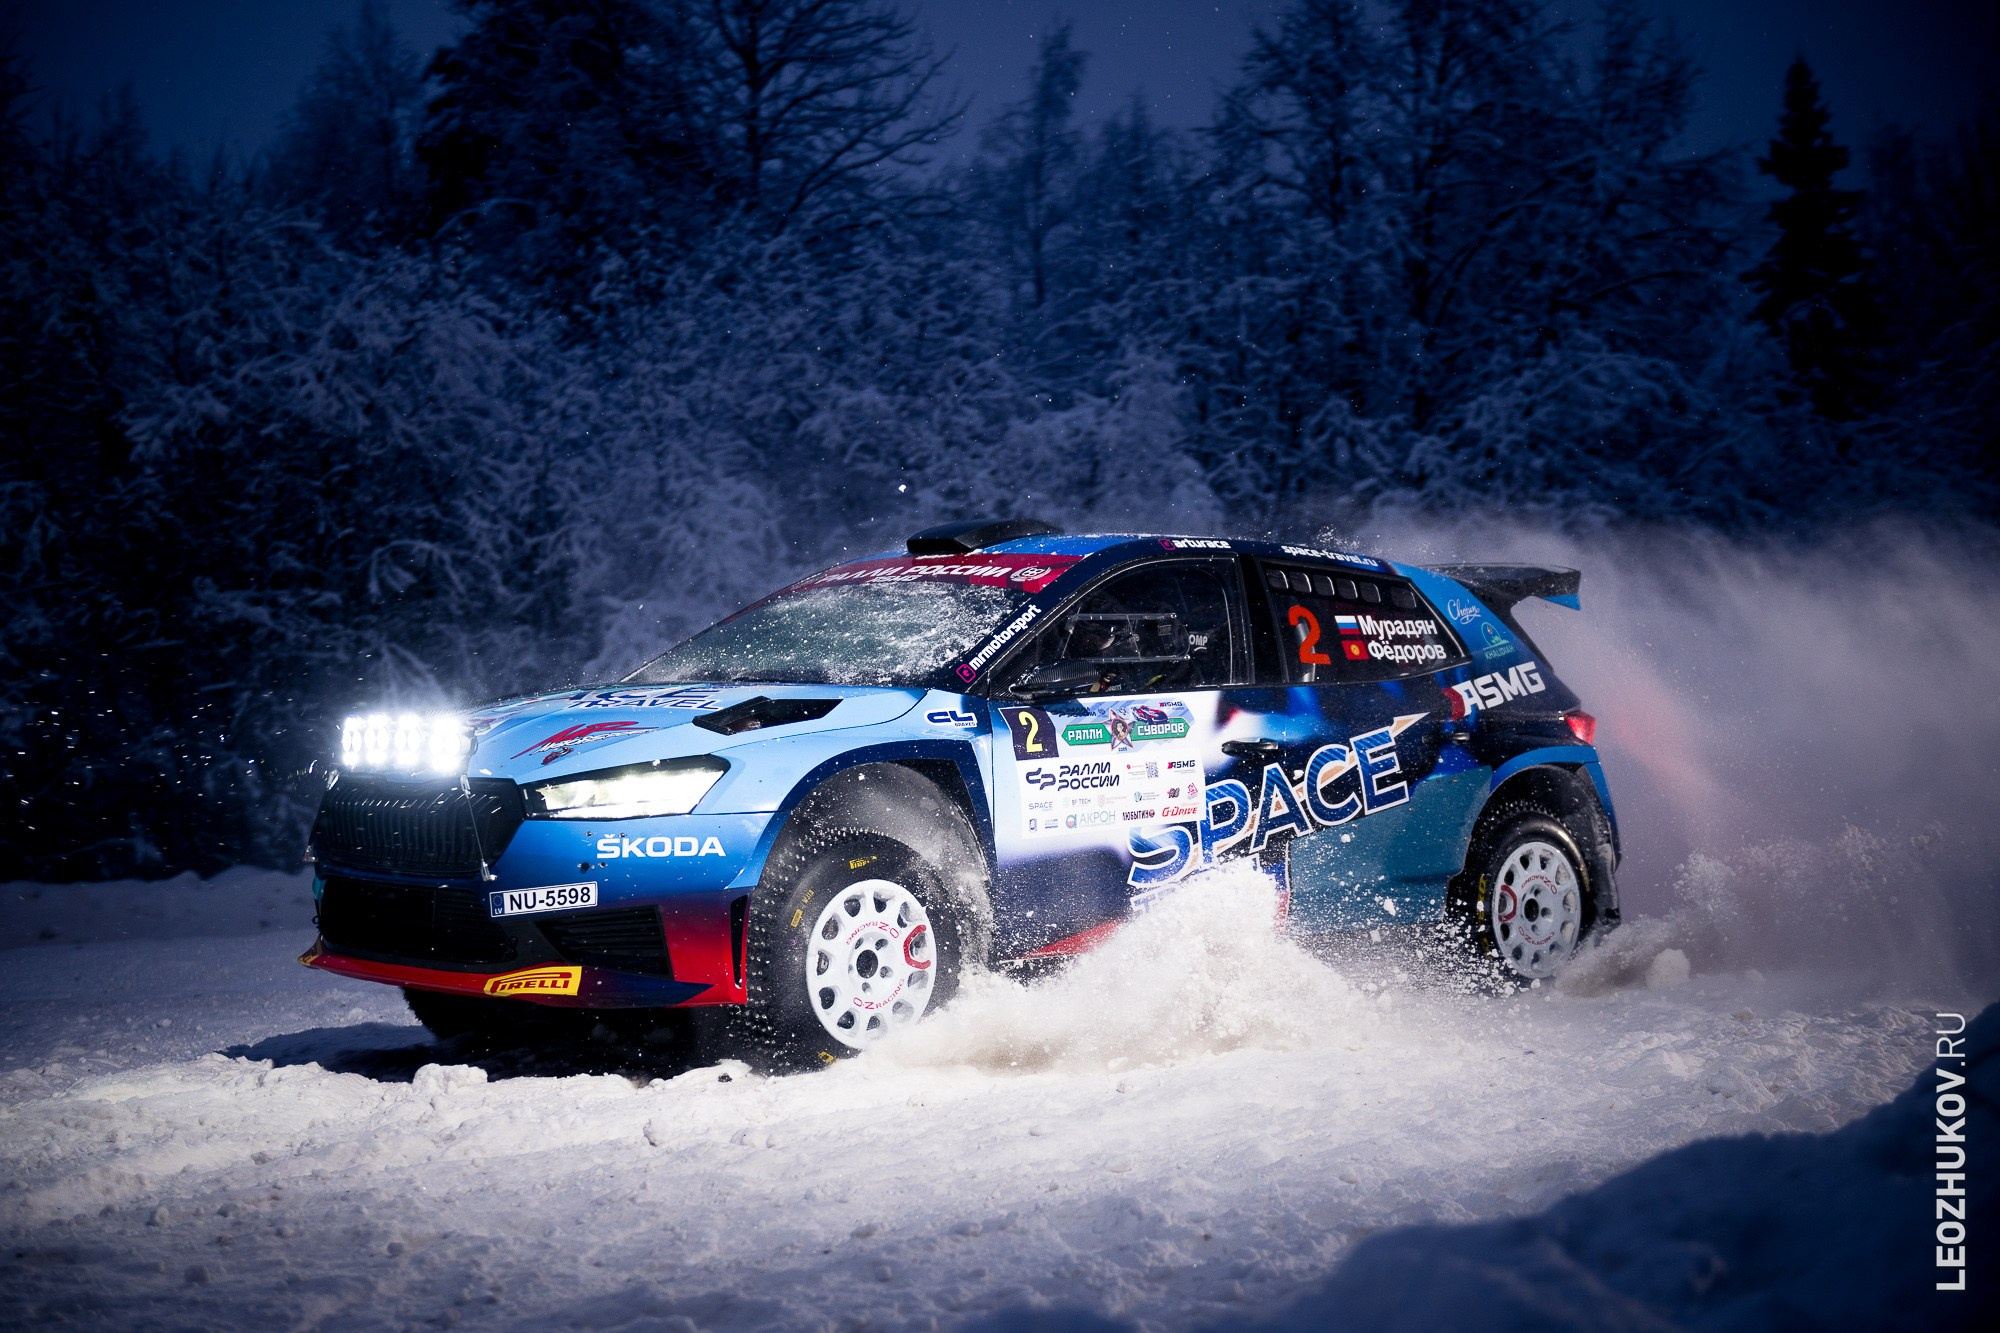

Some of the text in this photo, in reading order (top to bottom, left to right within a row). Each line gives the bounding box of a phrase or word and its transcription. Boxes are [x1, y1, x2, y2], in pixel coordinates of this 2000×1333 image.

[1173, 538, 1232, 549] arturace
[1281, 545, 1380, 567] space-travel.ru
[902, 565, 1012, 577] РОССИИ
[968, 604, 1042, 671] mrmotorsport
[1288, 605, 1331, 666] 2
[1357, 615, 1438, 640] Мурадян
[1188, 634, 1208, 646] OMP
[1367, 640, 1447, 664] Фёдоров
[1451, 661, 1546, 717] ASMG
[568, 700, 720, 710] TRAVEL
[1018, 711, 1043, 752] 2
[1068, 723, 1185, 741] РАЛЛИ СУВОРОВ
[1059, 761, 1111, 777] РАЛЛИ
[1058, 775, 1120, 791] РОССИИ
[1029, 801, 1054, 810] SPACE
[1127, 726, 1410, 889] SPACE
[1080, 810, 1116, 824] АКРОН
[596, 834, 727, 859] ŠKODA
[509, 886, 591, 911] NU-5598
[490, 972, 573, 994] PIRELLI
